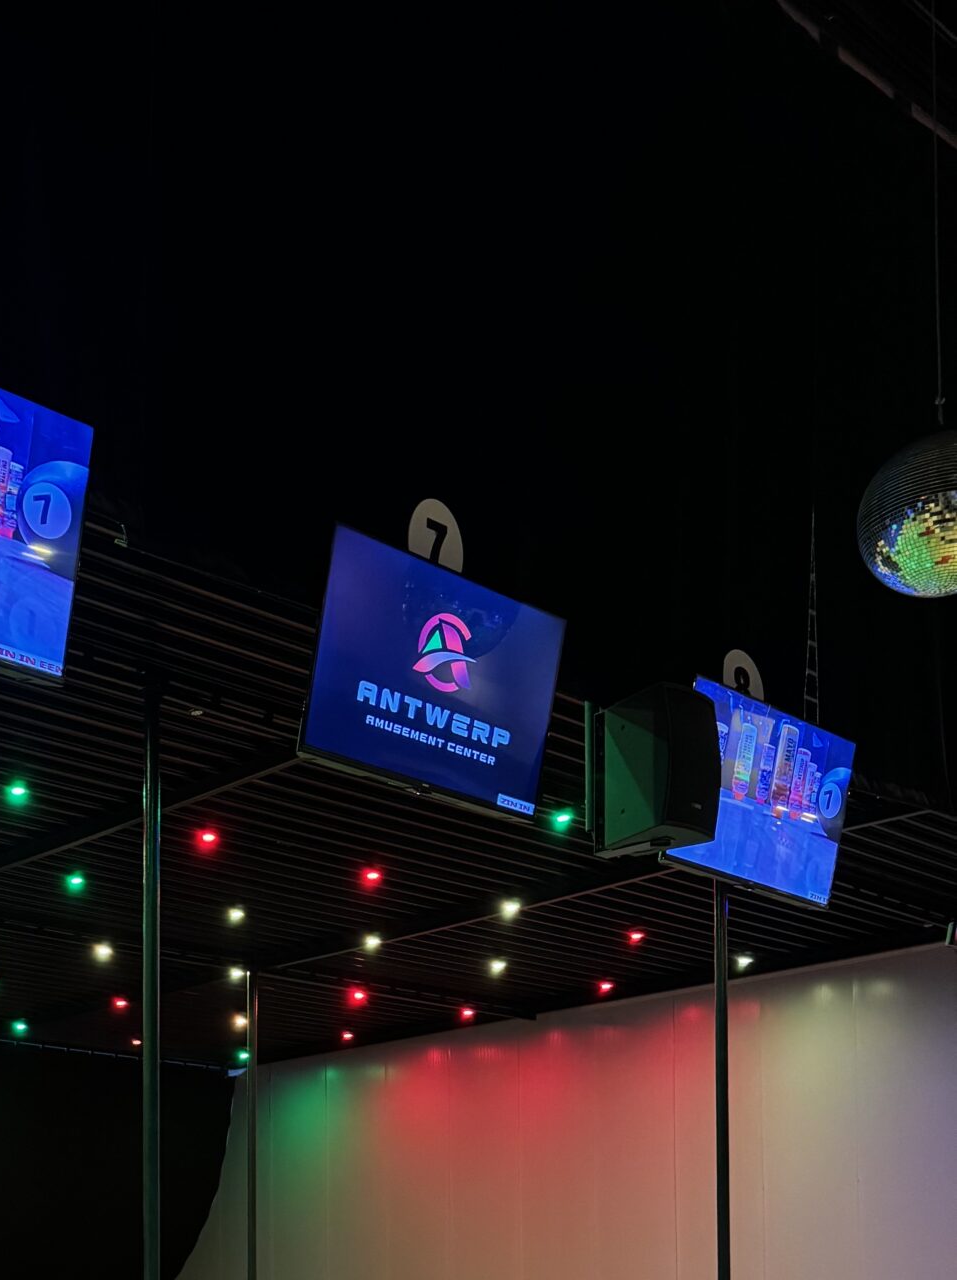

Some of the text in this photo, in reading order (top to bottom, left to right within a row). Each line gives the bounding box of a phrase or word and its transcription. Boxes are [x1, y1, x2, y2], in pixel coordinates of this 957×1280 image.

[33, 494, 52, 525] 7
[425, 517, 448, 564] 7
[19, 654, 36, 666] IN
[356, 680, 511, 748] ANTWERP
[365, 714, 496, 766] AMUSEMENT CENTER
[823, 790, 833, 810] 7
